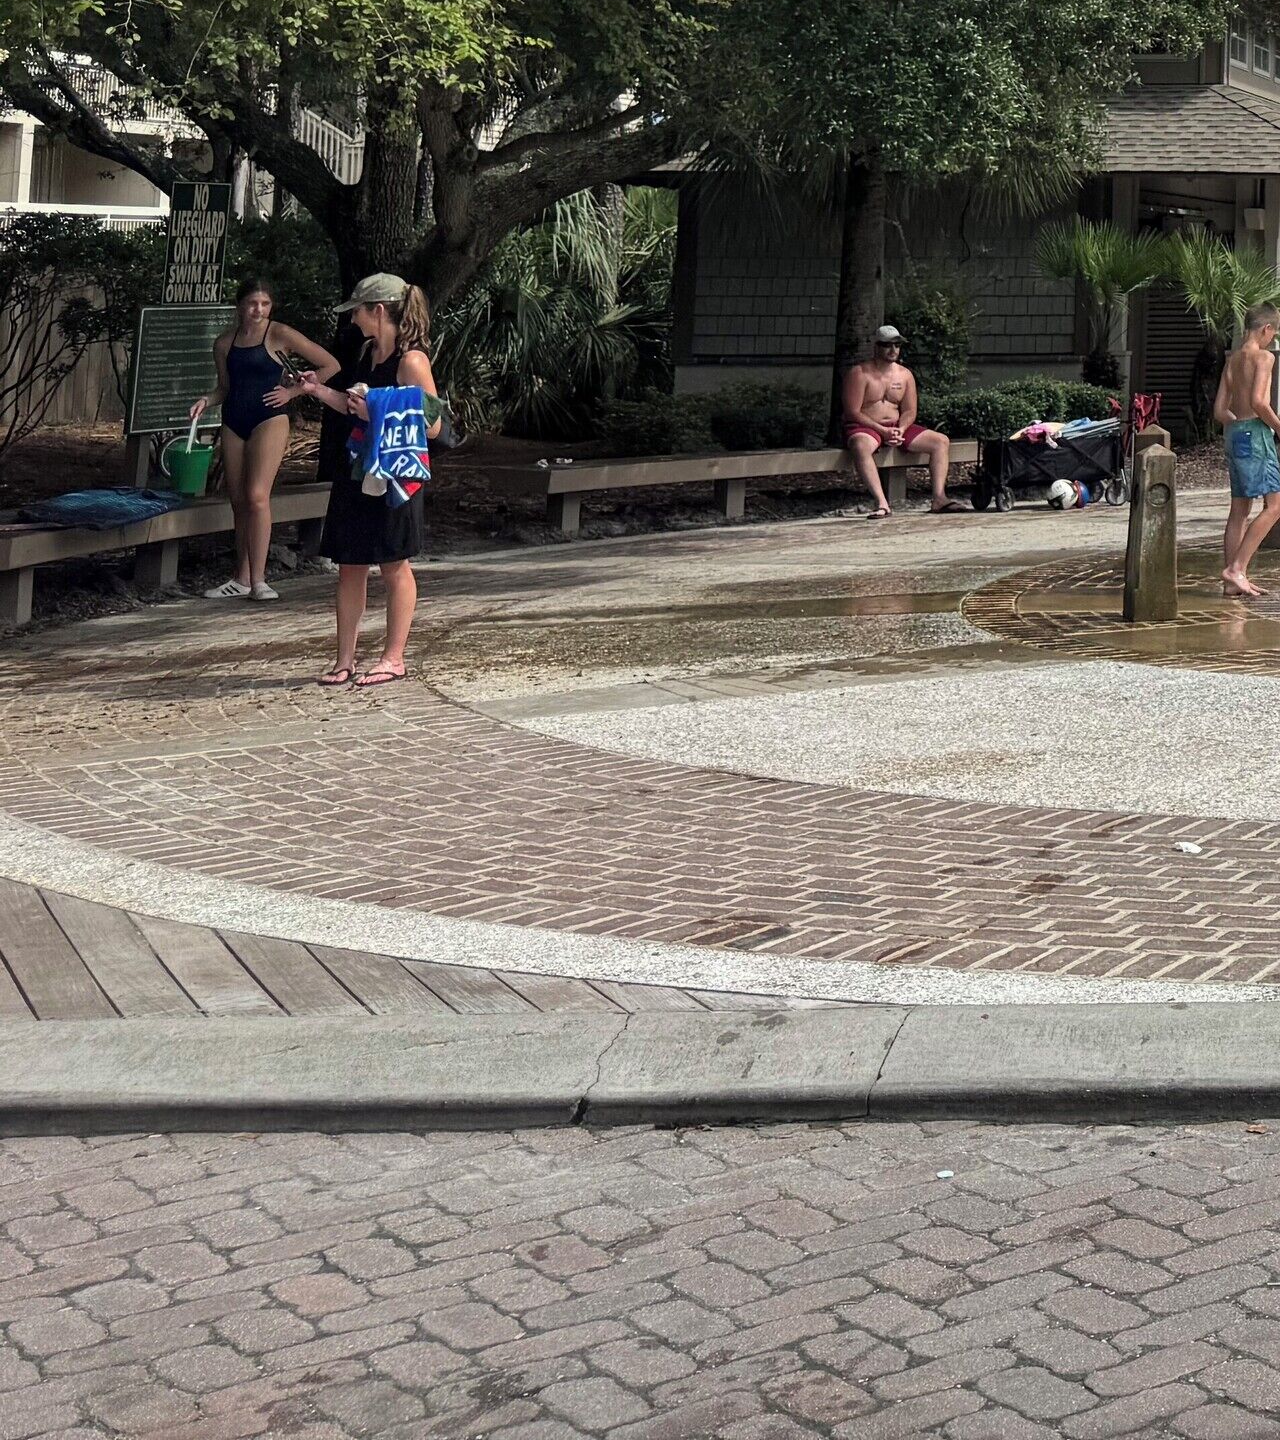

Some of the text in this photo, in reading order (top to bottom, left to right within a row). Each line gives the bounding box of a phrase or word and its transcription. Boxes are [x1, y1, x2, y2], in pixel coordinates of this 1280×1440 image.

[193, 184, 210, 211] NO
[171, 210, 226, 237] LIFEGUARD
[174, 237, 220, 263] ON DUTY
[169, 265, 219, 283] SWIM AT
[165, 283, 219, 302] OWN RISK
[380, 424, 418, 448] NEW
